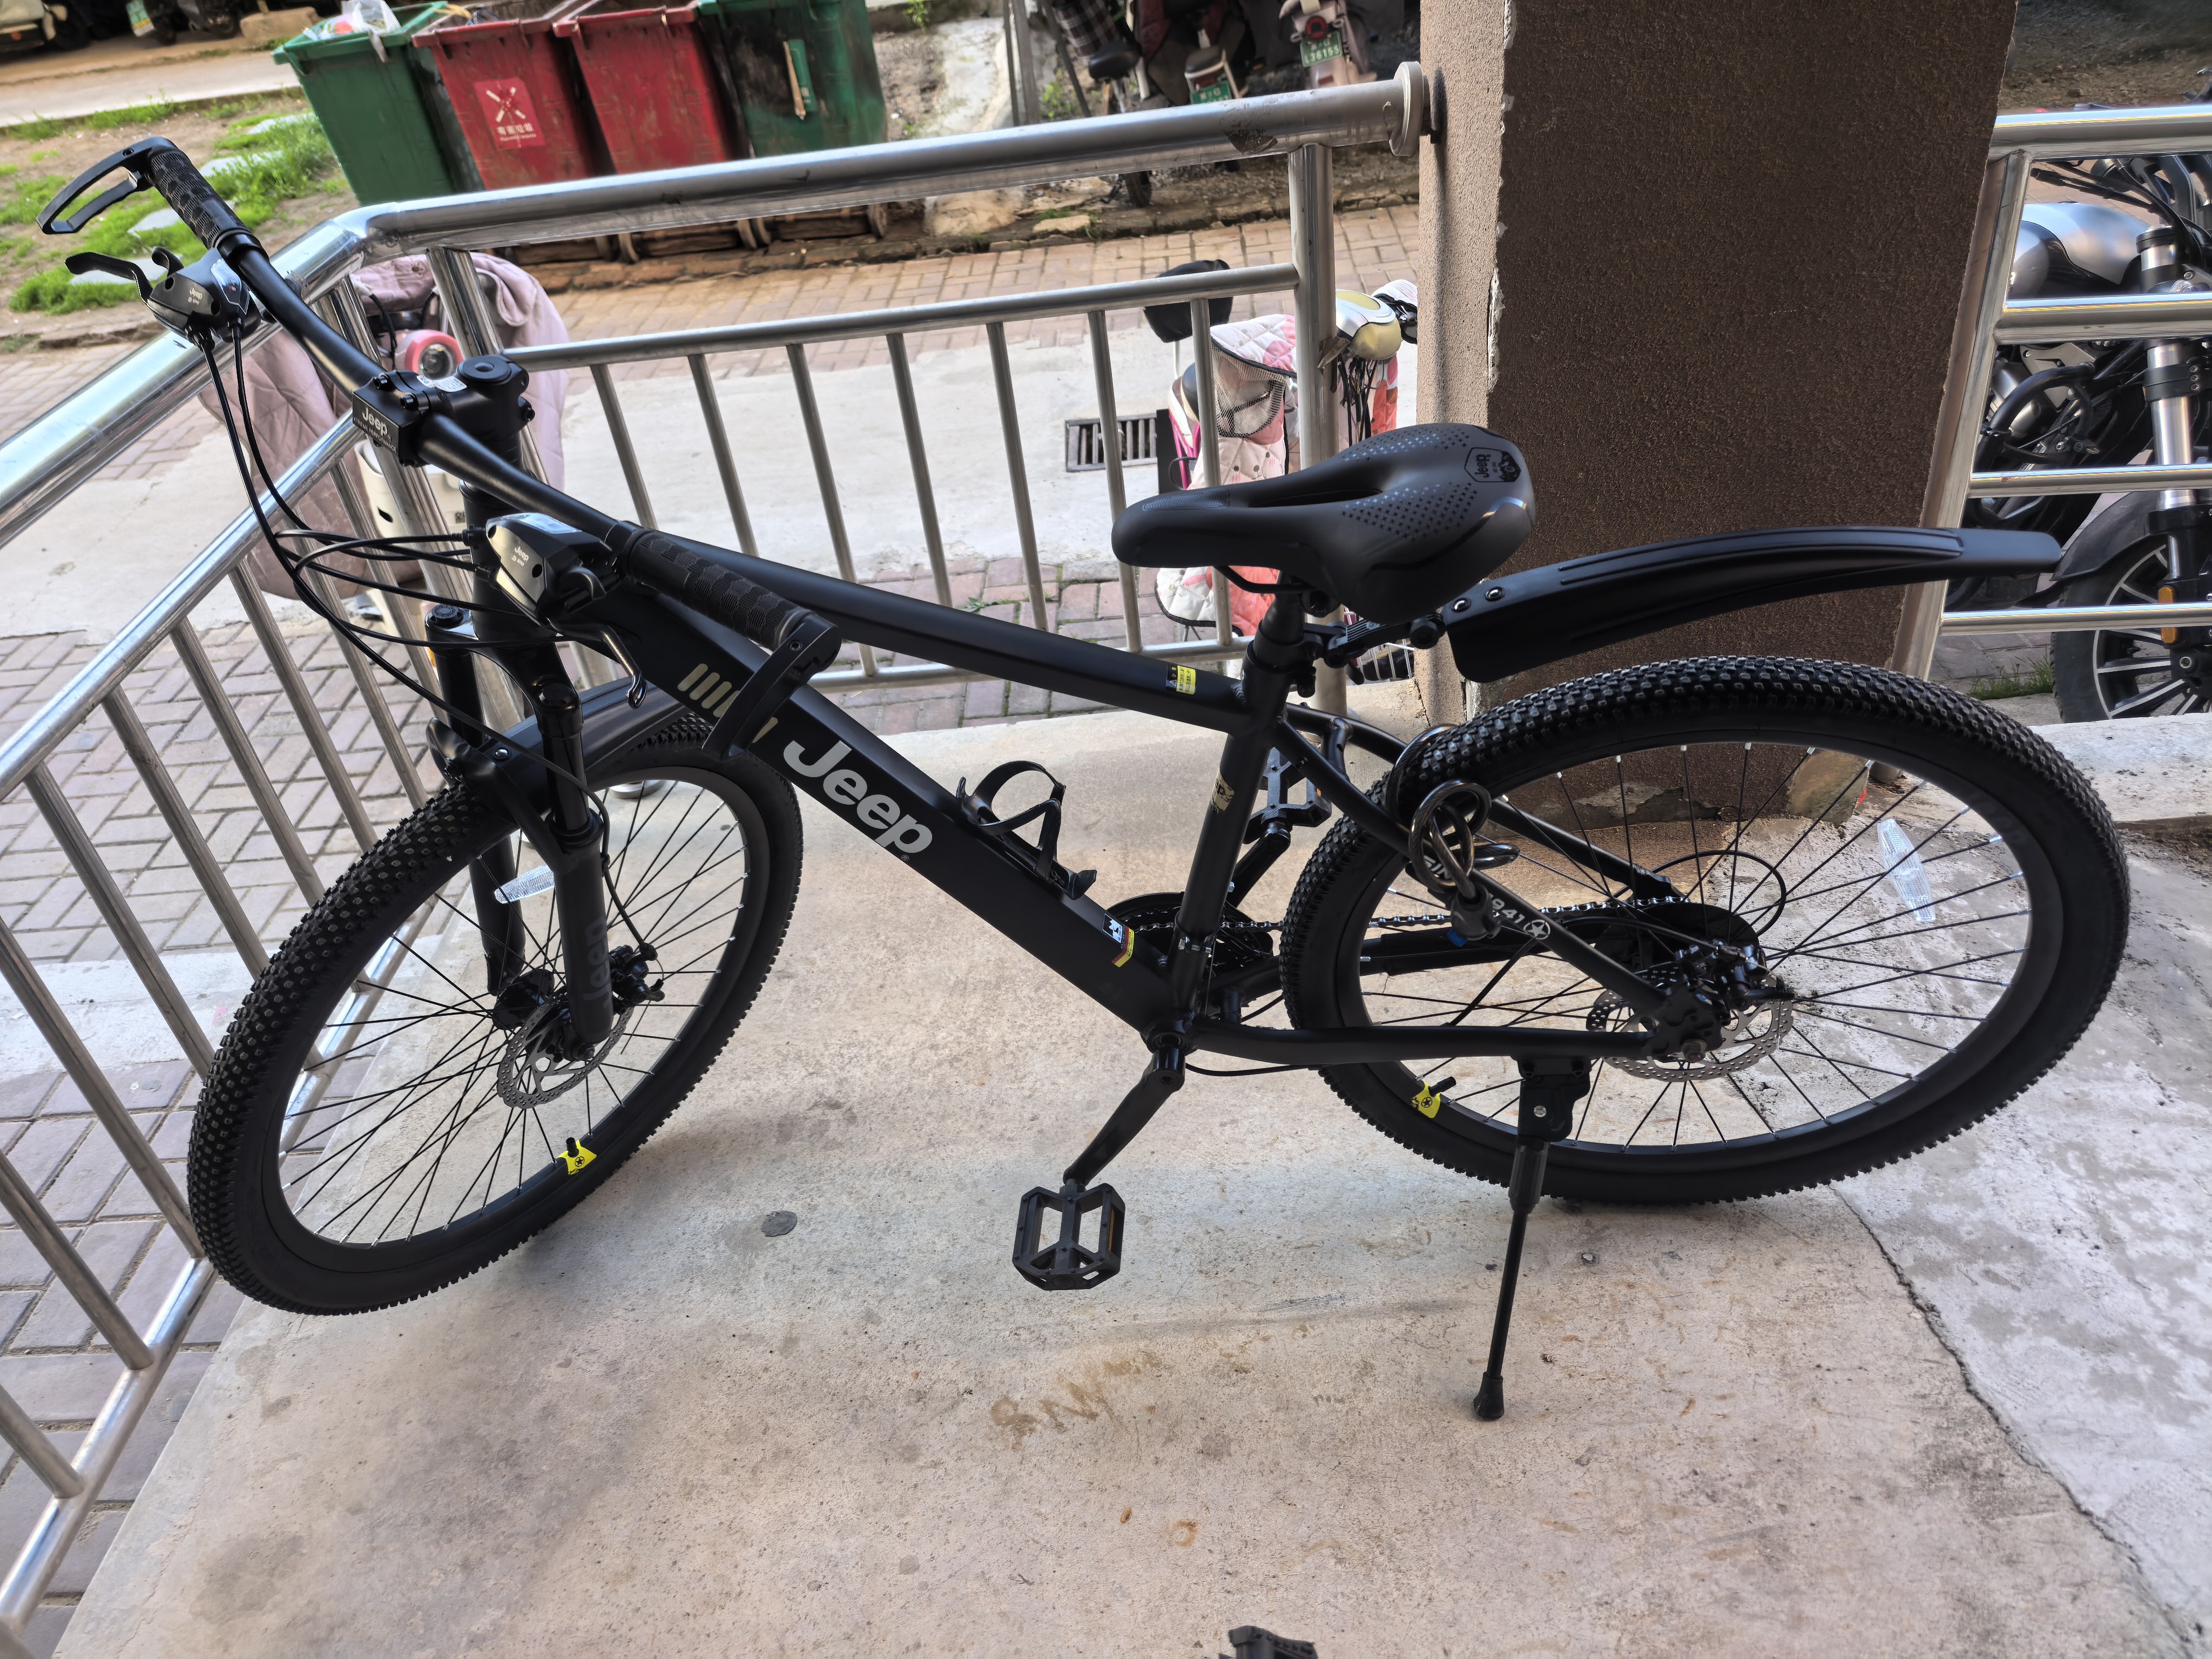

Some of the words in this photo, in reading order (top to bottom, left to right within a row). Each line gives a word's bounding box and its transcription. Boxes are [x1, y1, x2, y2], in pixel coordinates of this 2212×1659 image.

[362, 407, 388, 436] Jeep
[515, 546, 529, 563] Jeep
[784, 740, 933, 853] Jeep
[1488, 893, 1526, 924] 941
